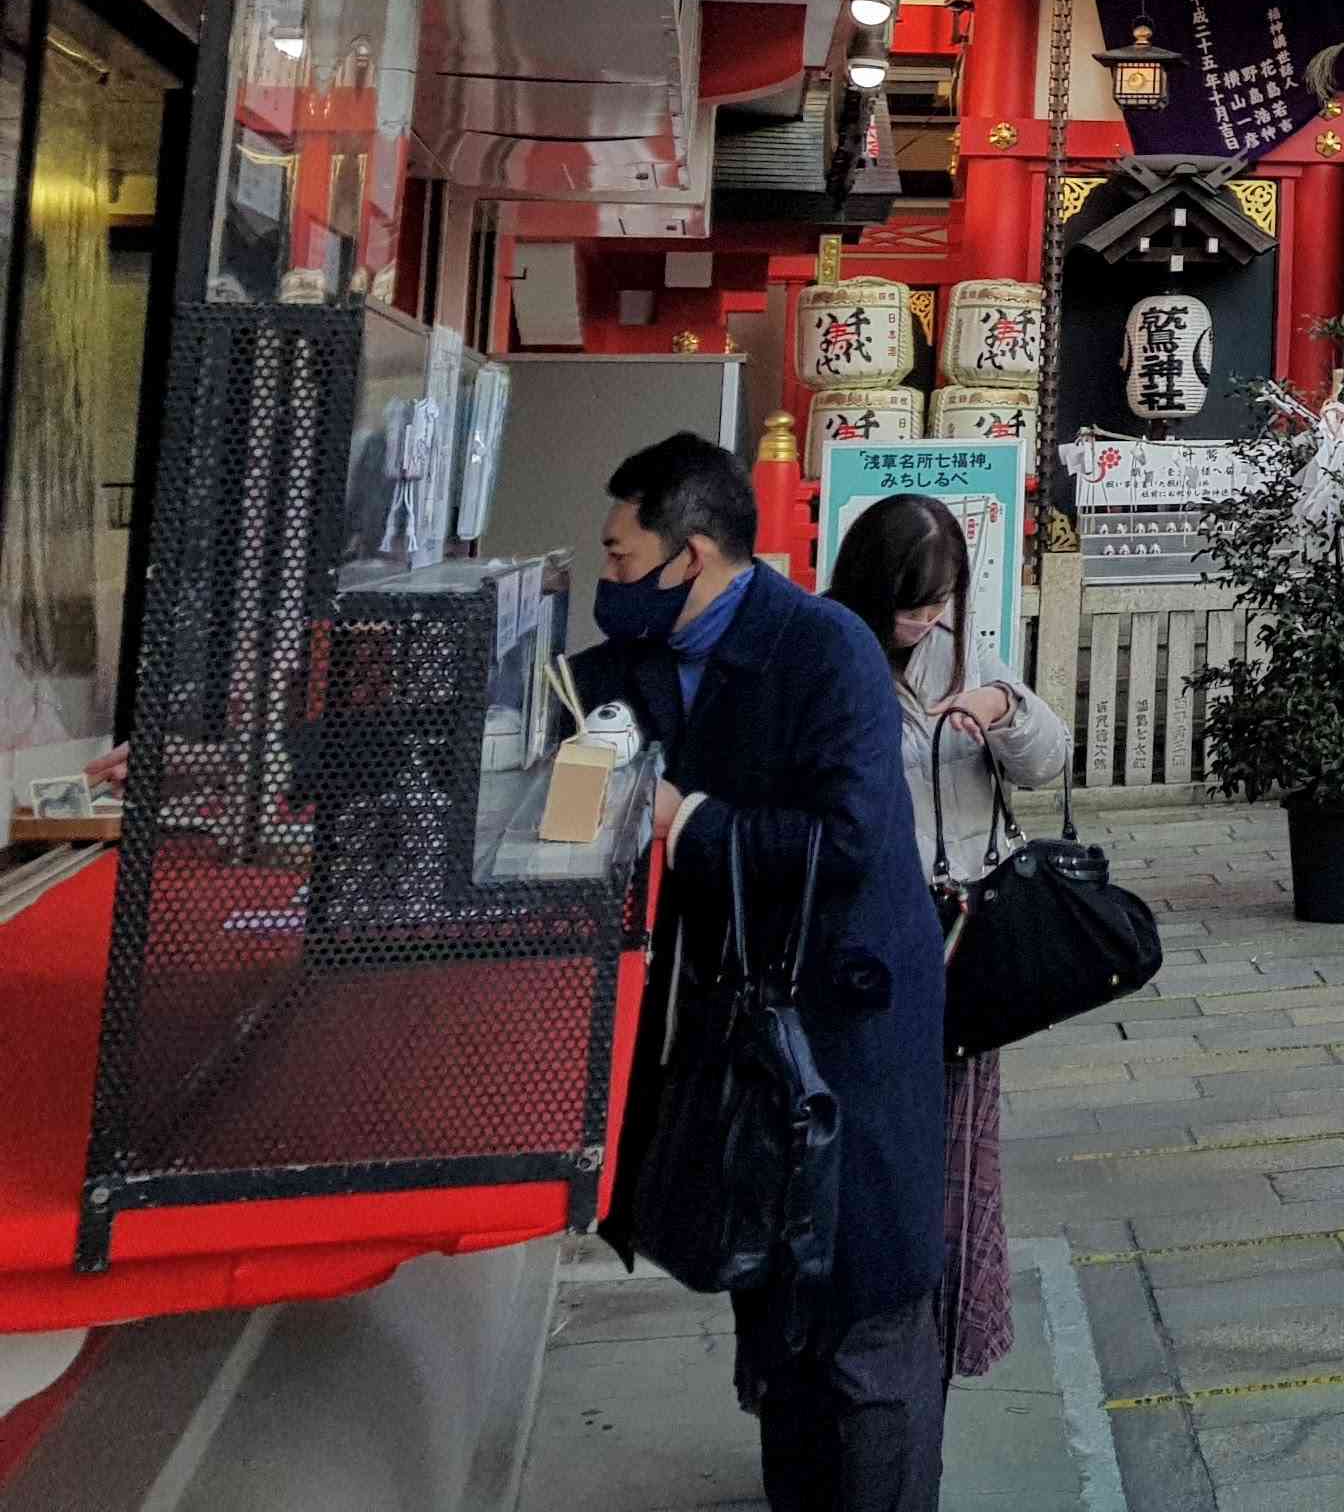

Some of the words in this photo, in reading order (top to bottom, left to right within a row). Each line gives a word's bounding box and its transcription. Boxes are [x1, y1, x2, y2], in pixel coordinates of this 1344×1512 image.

[1138, 306, 1188, 411] 鷲神社
[860, 450, 992, 471] 「浅草名所七福神」
[880, 472, 969, 488] みちしるべ
